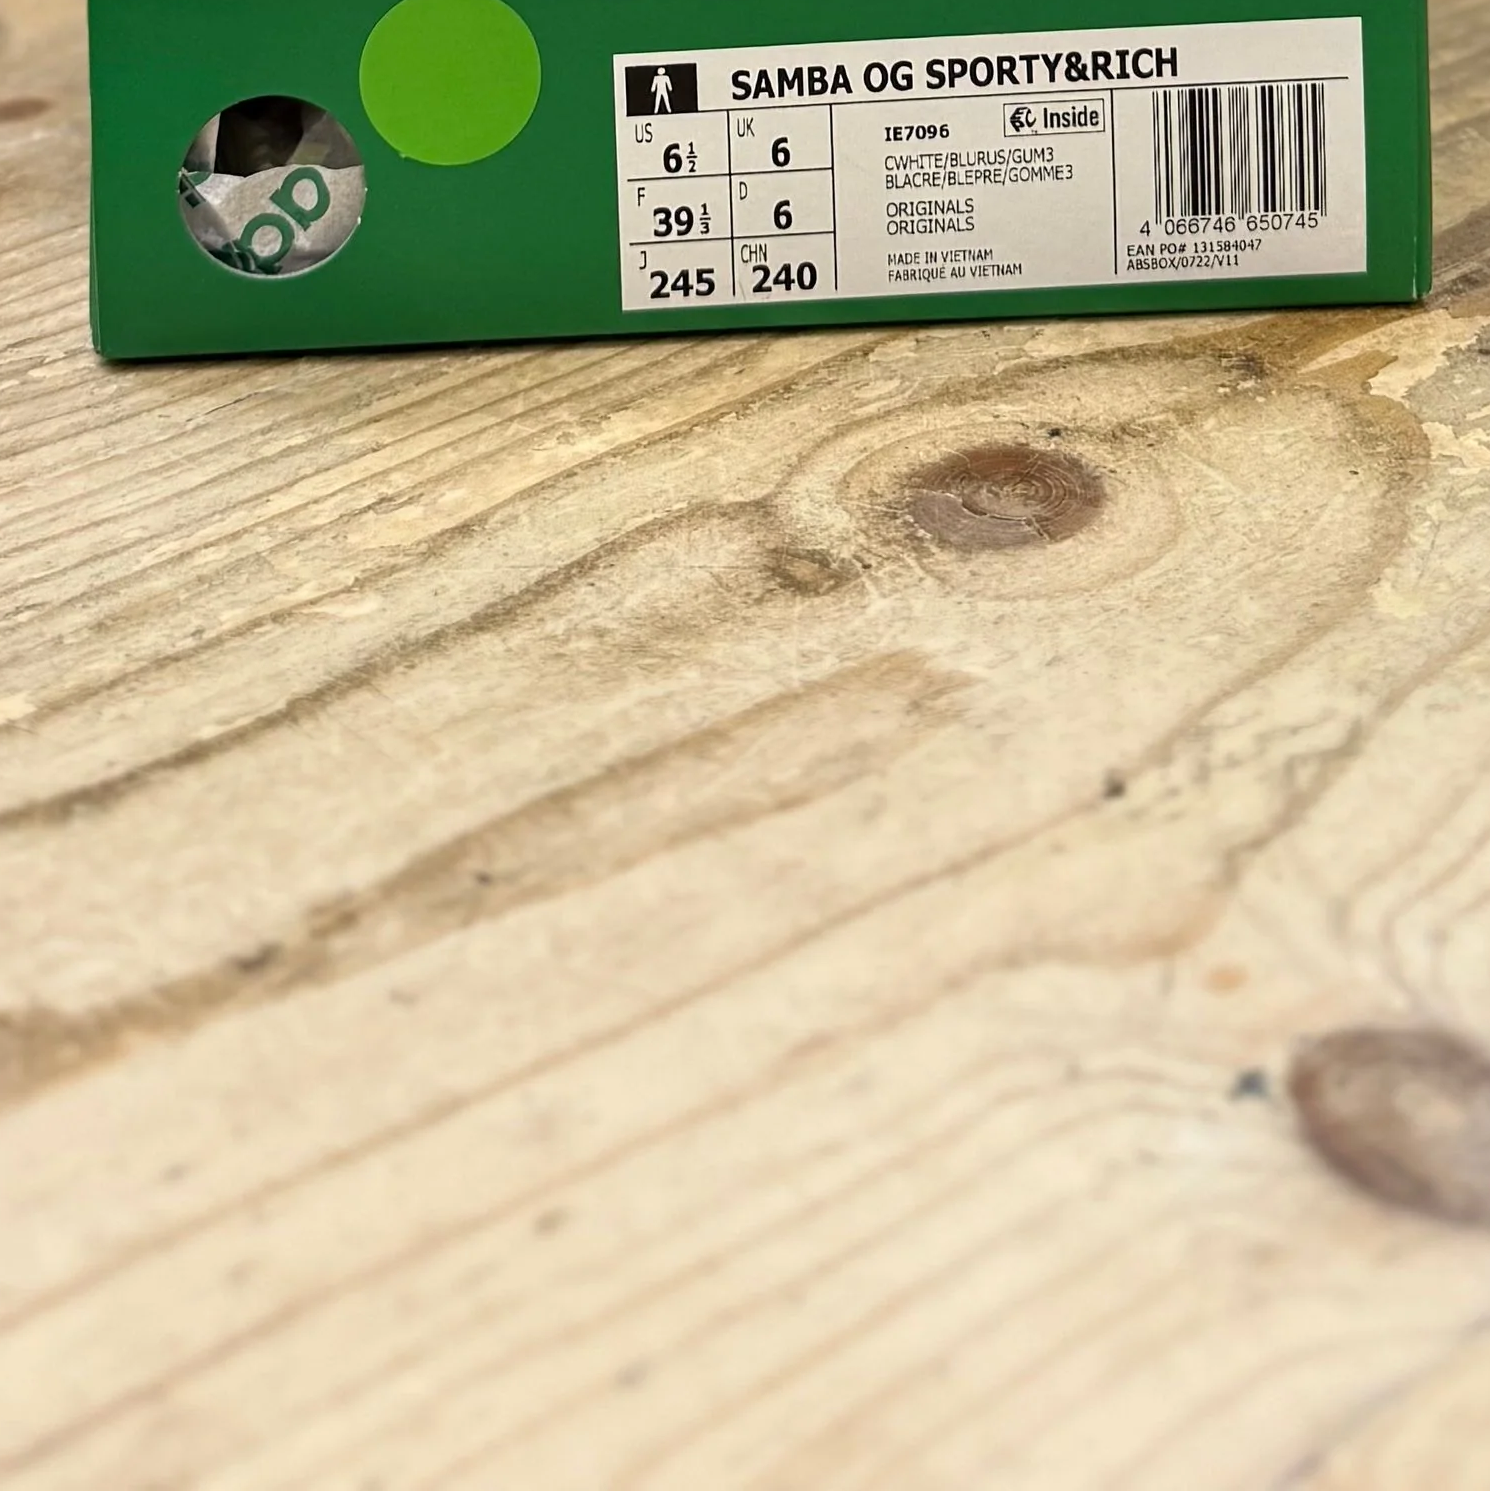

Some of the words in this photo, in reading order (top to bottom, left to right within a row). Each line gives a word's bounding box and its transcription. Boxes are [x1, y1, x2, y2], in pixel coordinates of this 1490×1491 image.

[731, 63, 854, 101] SAMBA
[863, 60, 914, 93] OG
[925, 47, 1179, 90] SPORTY&RICH
[1043, 104, 1100, 129] Inside
[635, 122, 654, 144] US
[737, 117, 755, 138] UK
[884, 124, 950, 142] IE7096
[771, 136, 791, 168] 6
[884, 147, 1054, 171] CWHITE/BLURUS/GUM3
[885, 164, 1073, 190] BLACRE/BLEPRE/GOMME3
[637, 187, 646, 207] F
[739, 181, 748, 200] D
[773, 199, 793, 230] 6
[886, 198, 974, 218] ORIGINALS
[886, 216, 975, 236] ORIGINALS
[1139, 220, 1151, 237] 4
[1164, 216, 1237, 236] 066746
[1246, 212, 1319, 233] 650745
[740, 243, 768, 264] CHN
[887, 251, 920, 266] MADE
[925, 250, 937, 265] IN
[941, 248, 993, 263] VIETNAM
[1127, 244, 1155, 257] EAN
[1159, 243, 1187, 256] PO#
[1193, 239, 1262, 254] 131584047
[639, 250, 648, 270] J
[752, 261, 818, 293] 240
[950, 265, 966, 279] AU
[969, 263, 1023, 278] VIETNAM
[650, 268, 716, 299] 245
